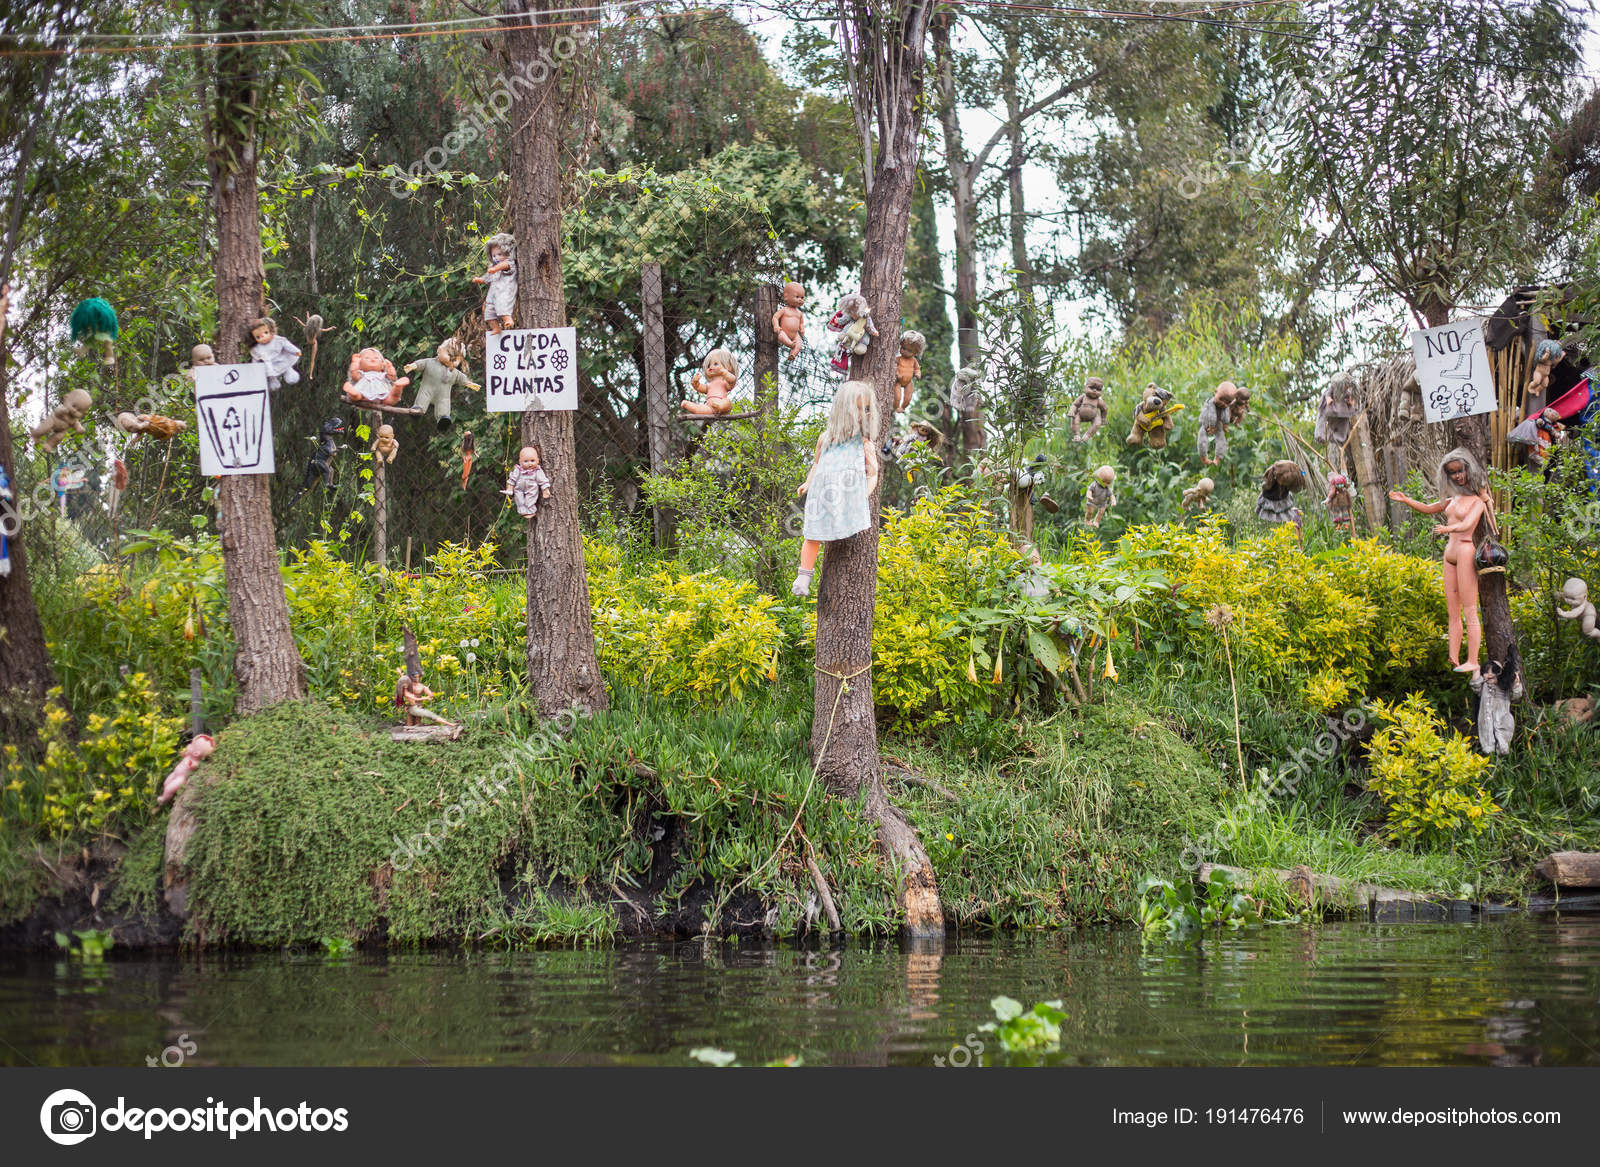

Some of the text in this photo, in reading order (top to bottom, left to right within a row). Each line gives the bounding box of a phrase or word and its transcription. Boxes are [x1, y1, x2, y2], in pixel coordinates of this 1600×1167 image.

[1425, 330, 1461, 358] NO
[517, 353, 548, 370] LAS
[490, 375, 565, 396] PLANTAS
